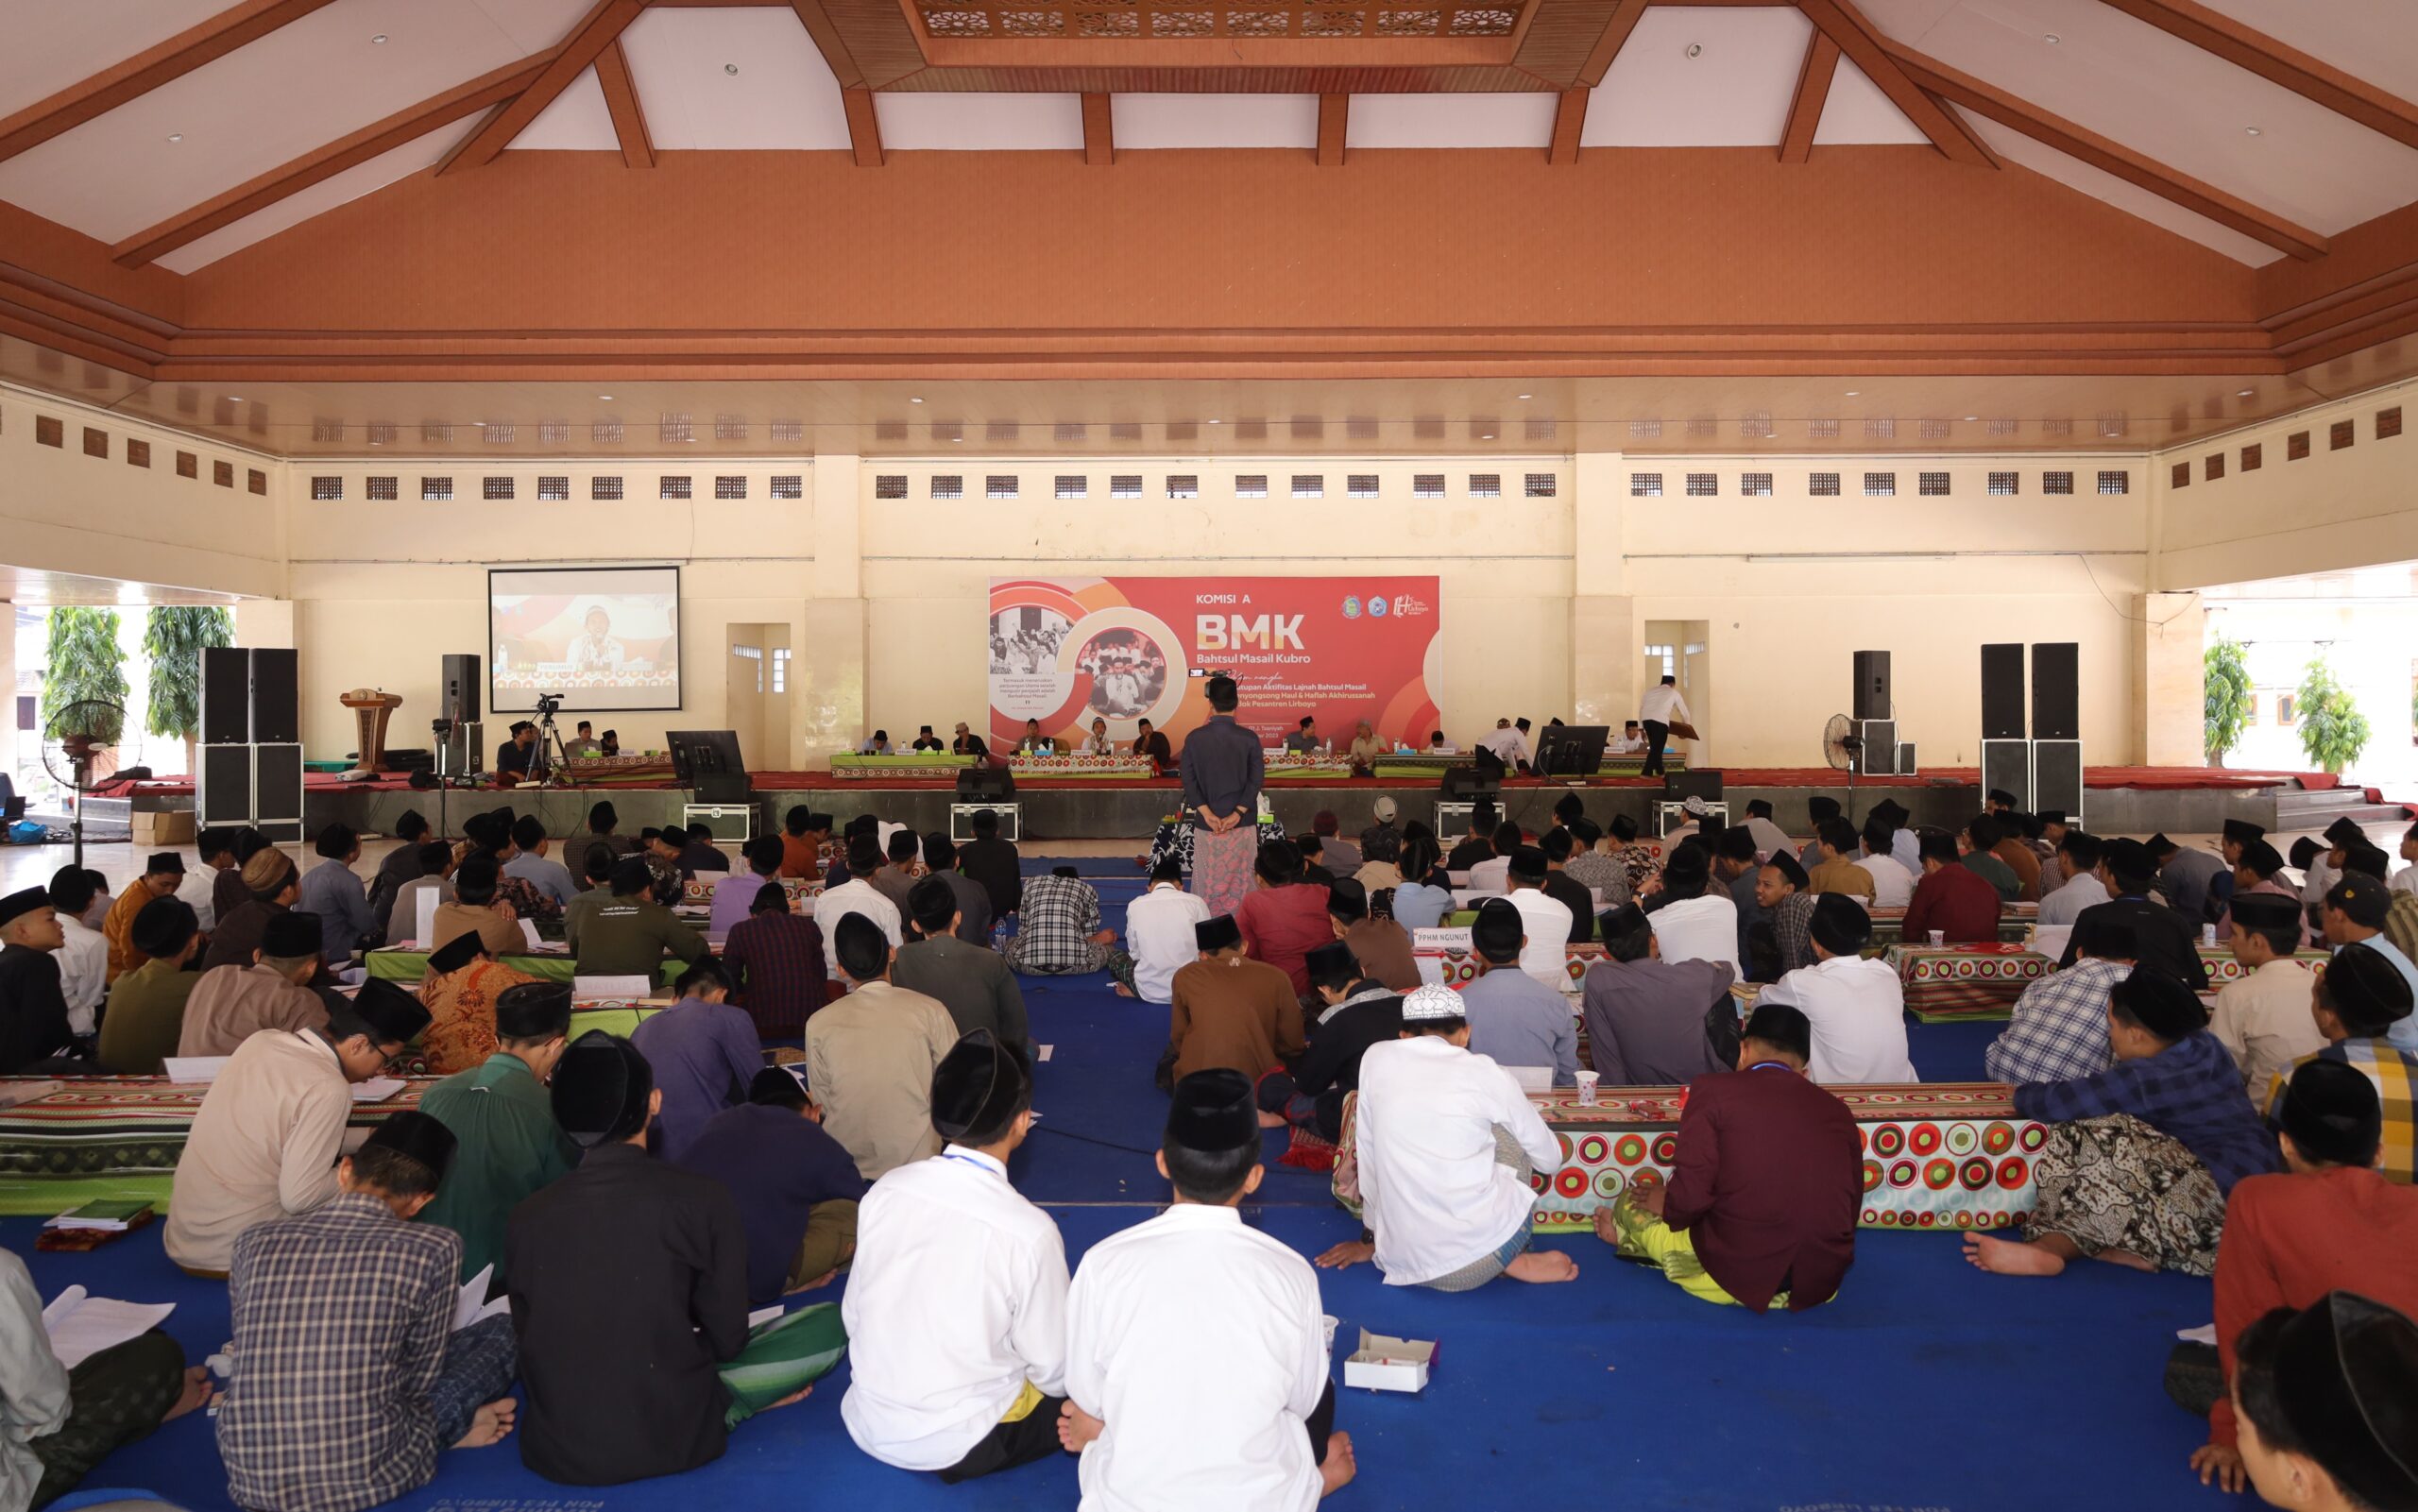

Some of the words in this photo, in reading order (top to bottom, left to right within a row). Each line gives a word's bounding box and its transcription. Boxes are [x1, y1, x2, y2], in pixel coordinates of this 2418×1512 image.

[1196, 594, 1236, 603] KOMISI
[1242, 594, 1251, 603] A
[1197, 614, 1304, 650] BMK
[1197, 654, 1237, 663] Bahtsul
[1240, 654, 1273, 663] Masail
[1276, 654, 1311, 663] Kubro
[1288, 700, 1317, 708] Lirboyo
[1440, 933, 1469, 942] NGUNUT
